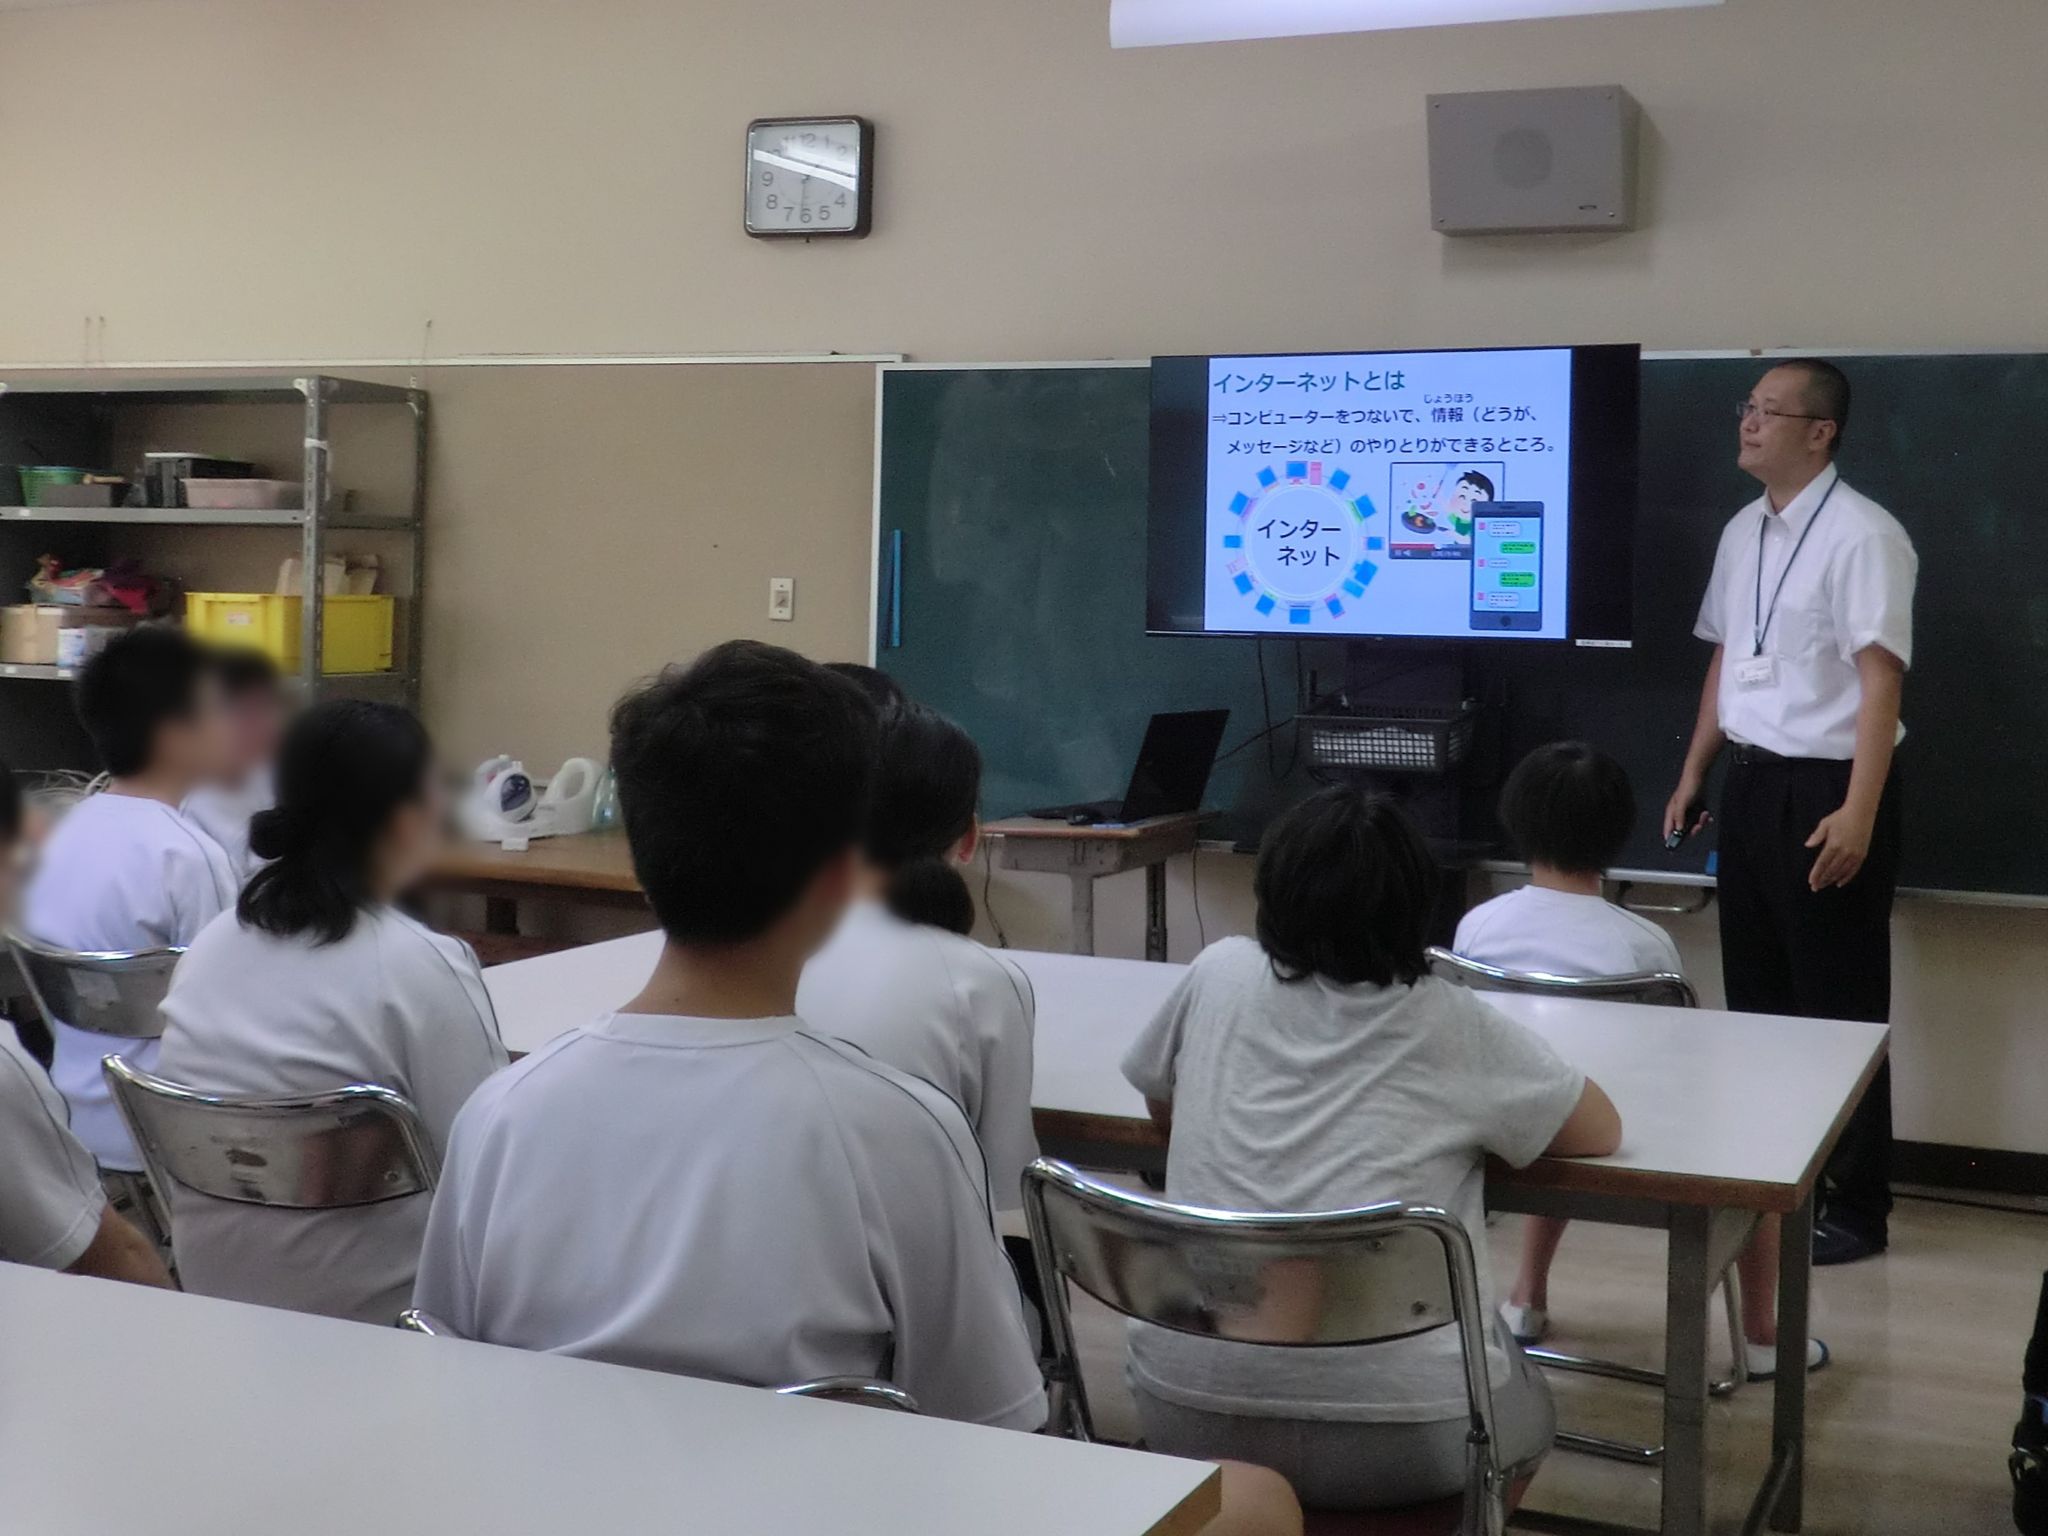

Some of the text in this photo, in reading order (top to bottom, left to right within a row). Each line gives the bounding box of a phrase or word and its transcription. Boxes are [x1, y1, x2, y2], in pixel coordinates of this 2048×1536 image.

[762, 171, 774, 187] 9
[766, 194, 778, 210] 8
[834, 192, 847, 208] 4
[783, 206, 795, 222] 7
[800, 208, 813, 224] 6
[819, 205, 831, 221] 5
[1213, 370, 1406, 394] インターネットとは
[1423, 393, 1474, 404] じょうほう
[1257, 519, 1342, 539] インター
[1277, 545, 1341, 567] ネット
